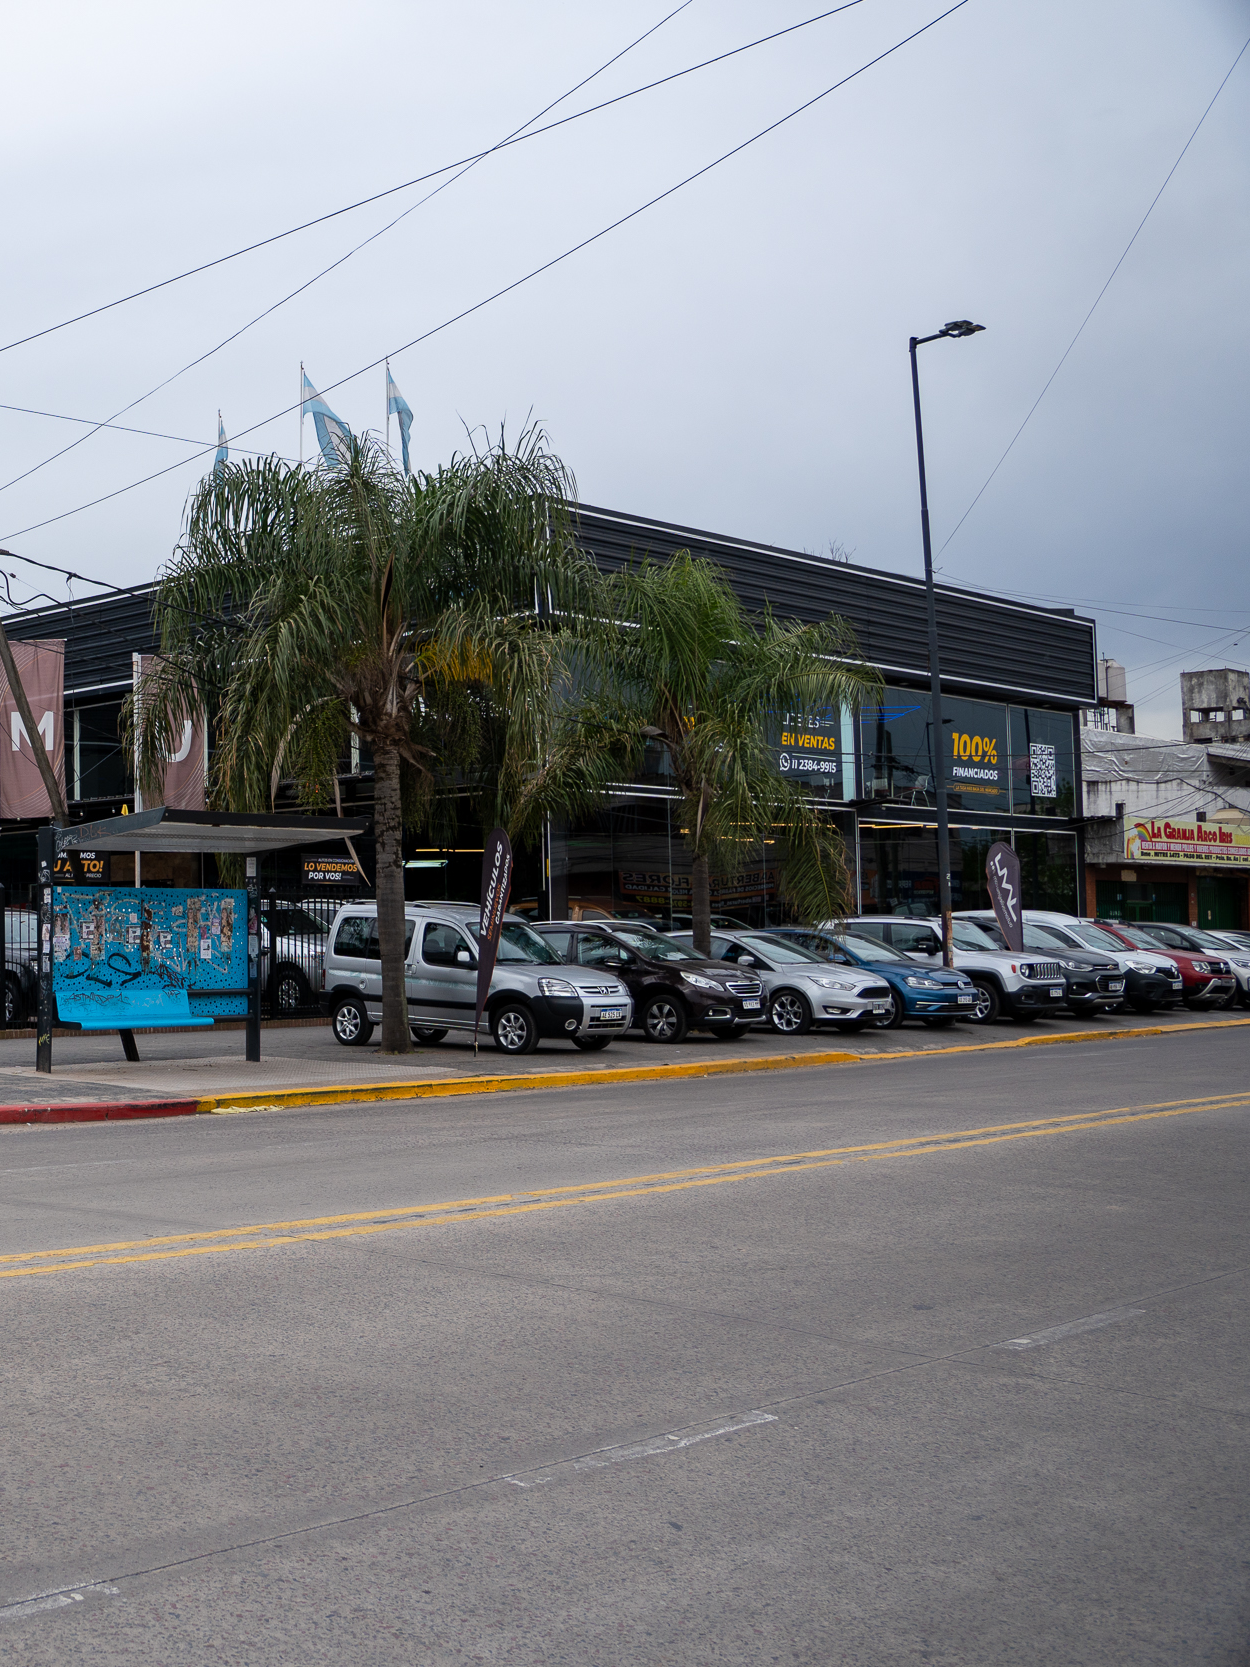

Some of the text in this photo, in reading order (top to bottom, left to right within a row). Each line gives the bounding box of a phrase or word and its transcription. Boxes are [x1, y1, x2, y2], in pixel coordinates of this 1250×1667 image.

[10, 710, 54, 751] M
[781, 732, 836, 750] EN VENTAS
[952, 732, 998, 764] 100%
[798, 759, 837, 773] 2384-9915
[952, 766, 998, 780] FINANCIADOS
[62, 860, 104, 872] ATO!
[304, 862, 358, 872] LO VENDEMOS
[308, 872, 342, 880] POR VOS!
